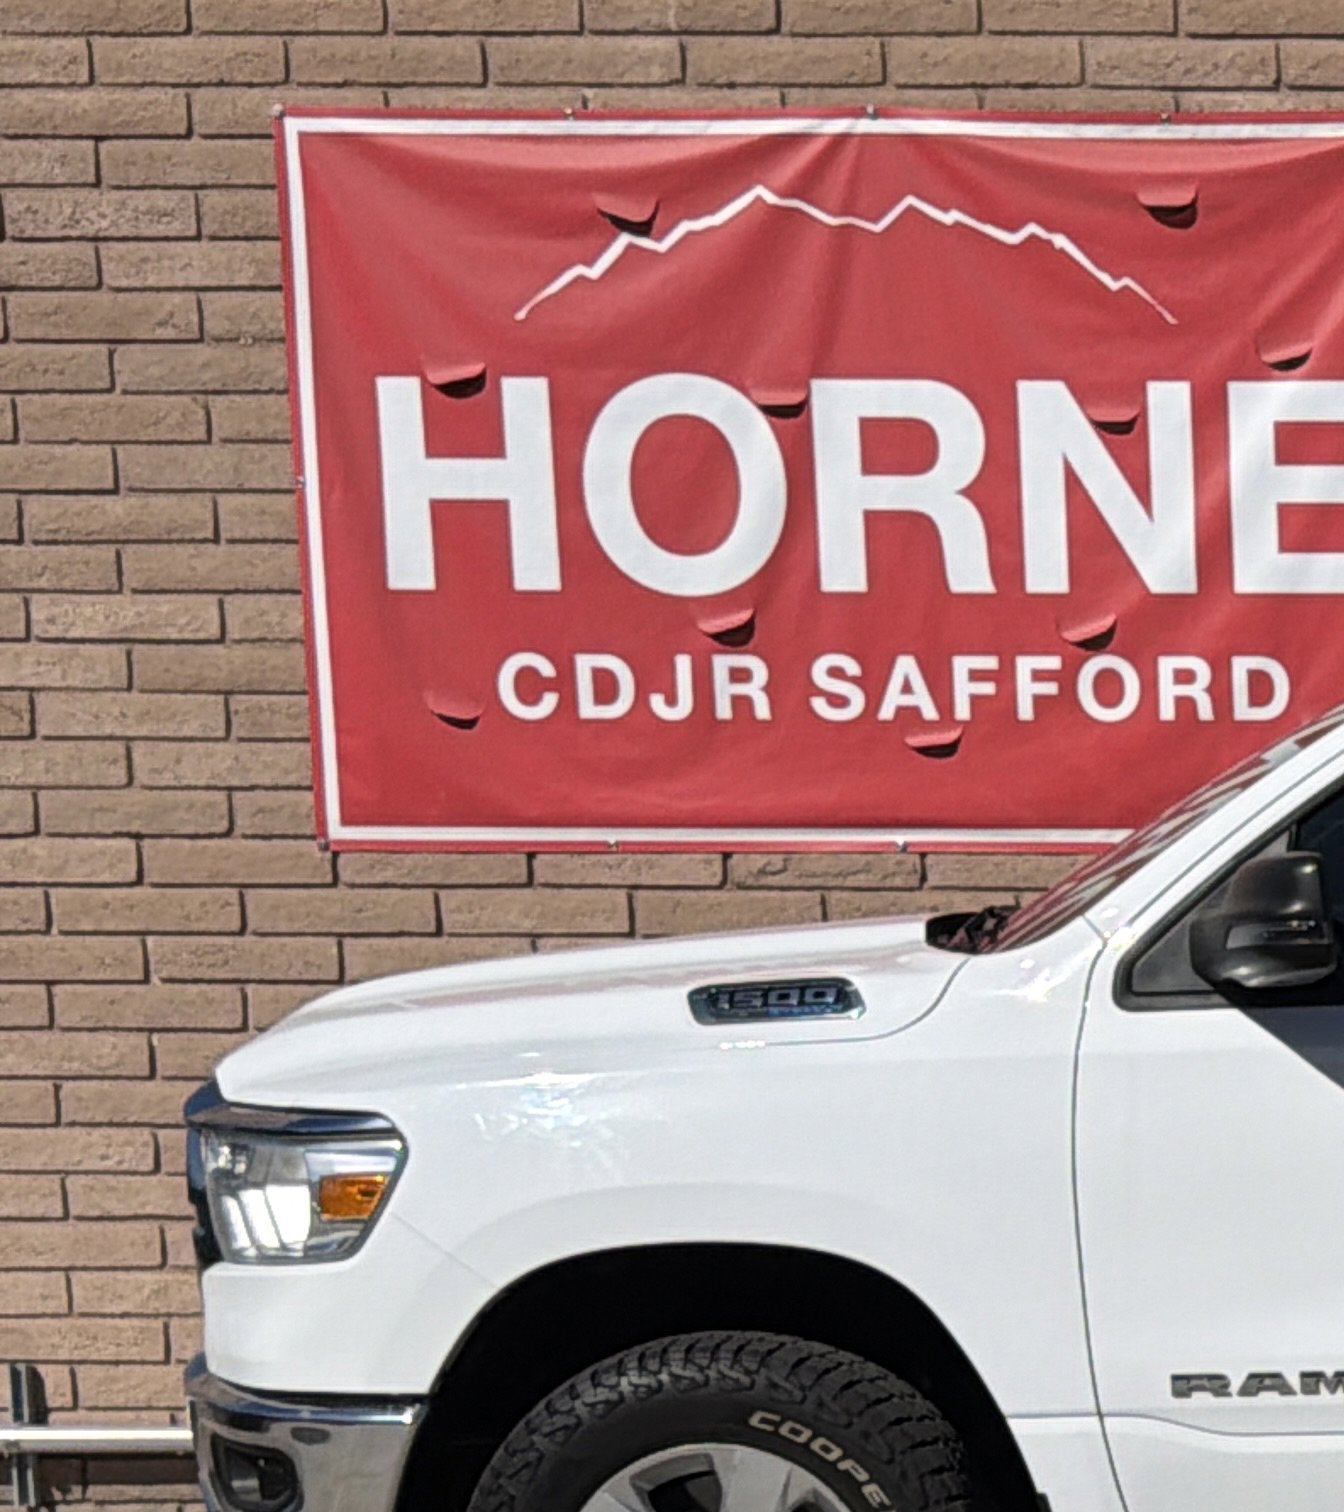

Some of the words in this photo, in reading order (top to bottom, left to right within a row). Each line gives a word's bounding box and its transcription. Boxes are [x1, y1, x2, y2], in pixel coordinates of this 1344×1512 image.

[497, 651, 770, 723] CDJR
[809, 653, 1291, 723] SAFFORD
[716, 988, 837, 1009] 1500
